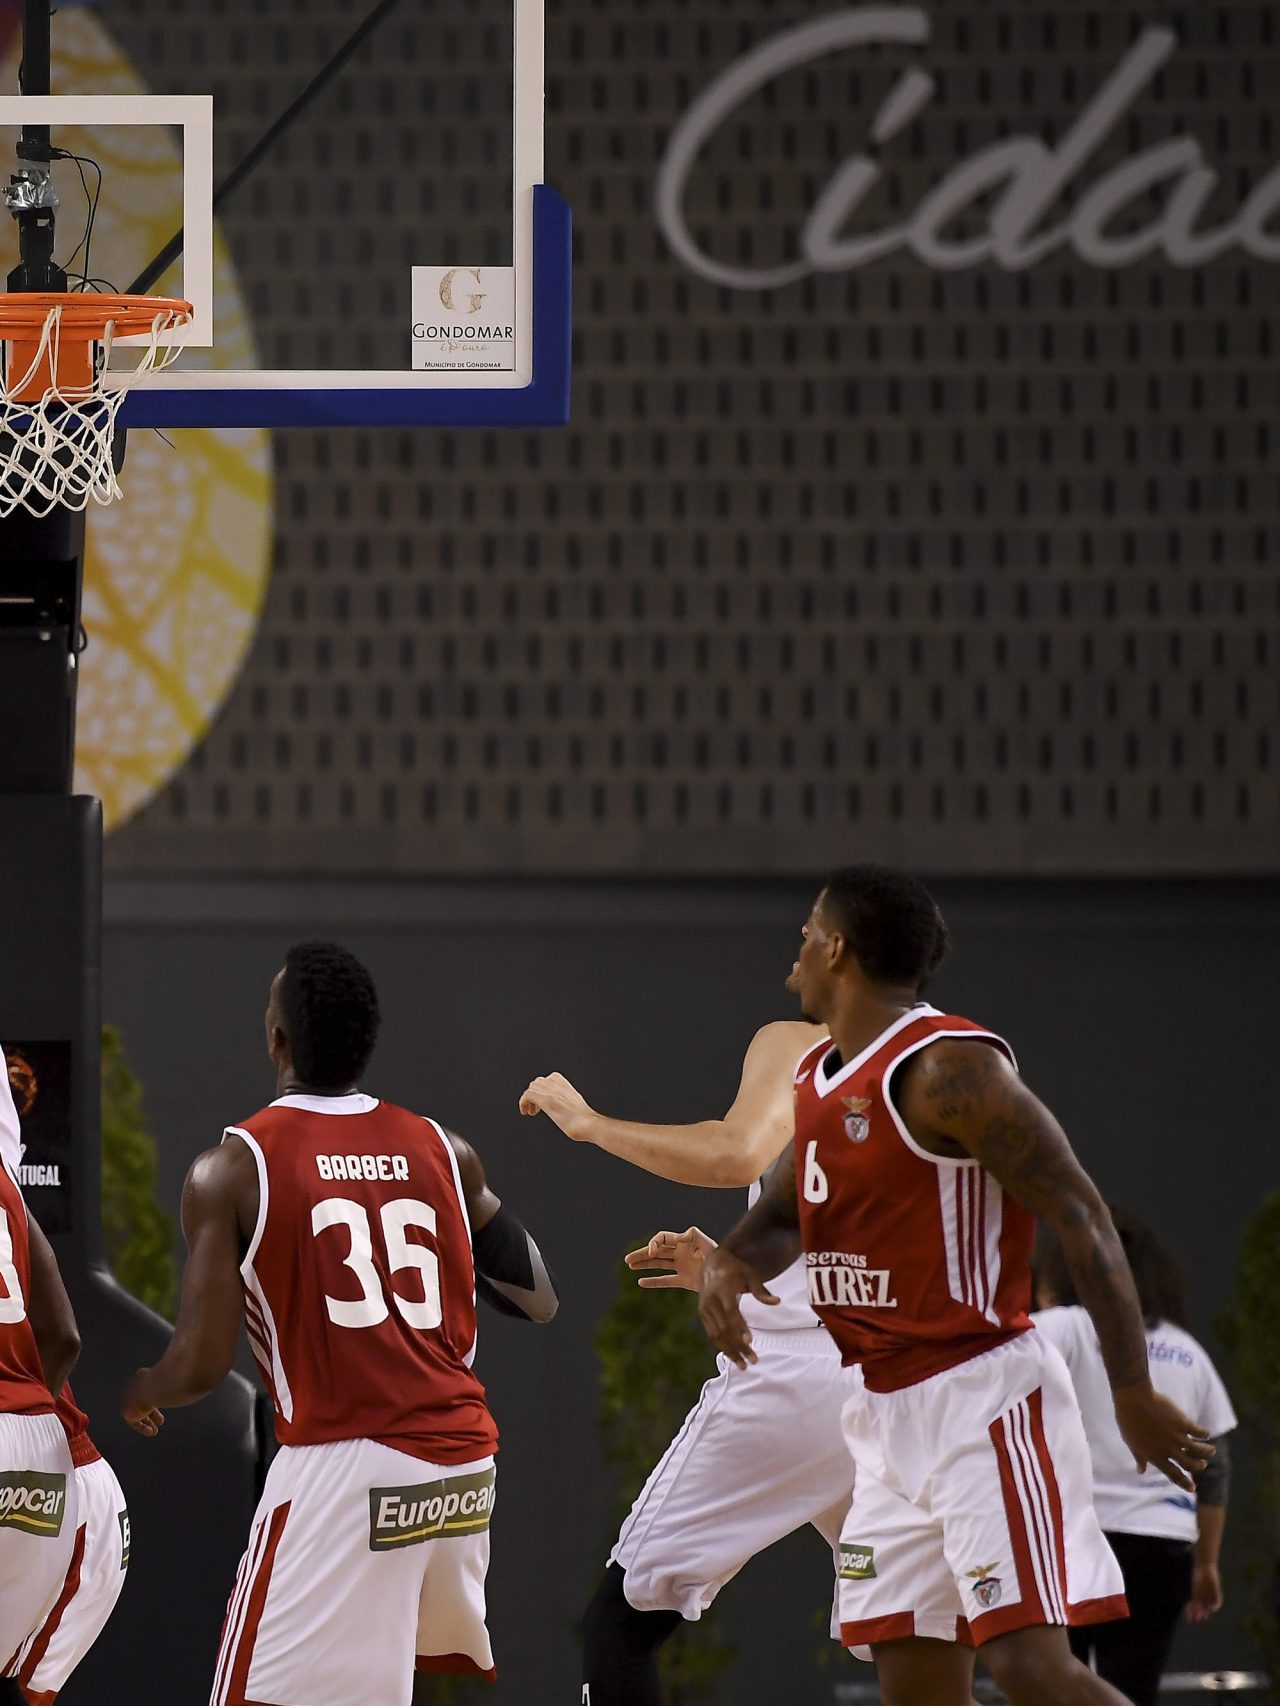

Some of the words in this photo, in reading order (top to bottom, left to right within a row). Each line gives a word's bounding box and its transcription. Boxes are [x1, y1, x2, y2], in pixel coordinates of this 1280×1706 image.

[655, 4, 1280, 291] Cida
[412, 322, 513, 339] GONDOMAR
[315, 1154, 410, 1181] BARBER
[803, 1139, 829, 1204] 6
[310, 1197, 443, 1330] 35
[376, 1482, 495, 1530] Europcar
